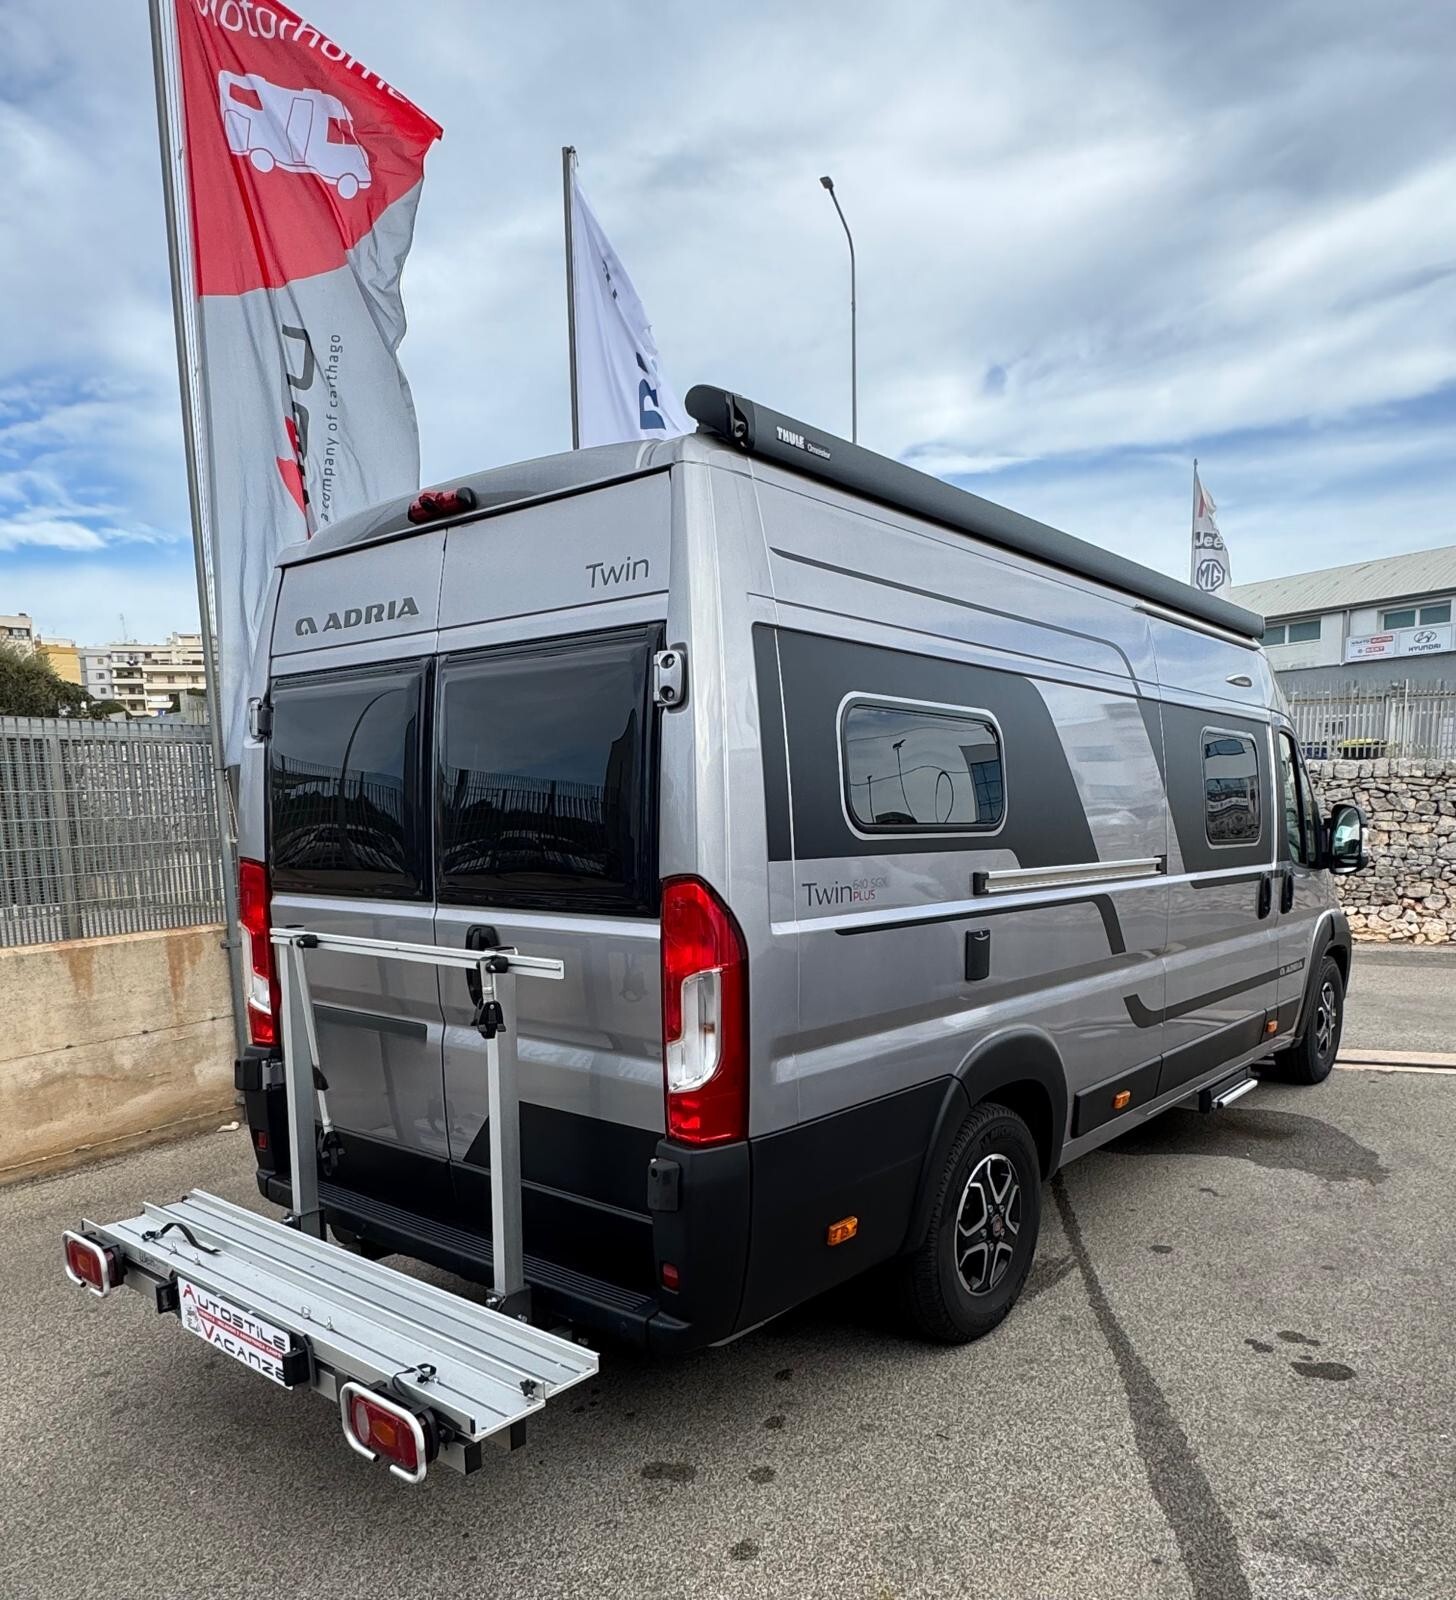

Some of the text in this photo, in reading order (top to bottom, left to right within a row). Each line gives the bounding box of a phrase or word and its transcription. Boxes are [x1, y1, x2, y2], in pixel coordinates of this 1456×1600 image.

[320, 334, 344, 522] a company of carthago
[776, 425, 805, 450] THULE
[585, 556, 649, 588] Twin
[322, 597, 420, 632] ADRIA
[1408, 643, 1442, 653] HYUNDAI
[801, 881, 853, 906] Twin
[853, 889, 876, 901] PLUS
